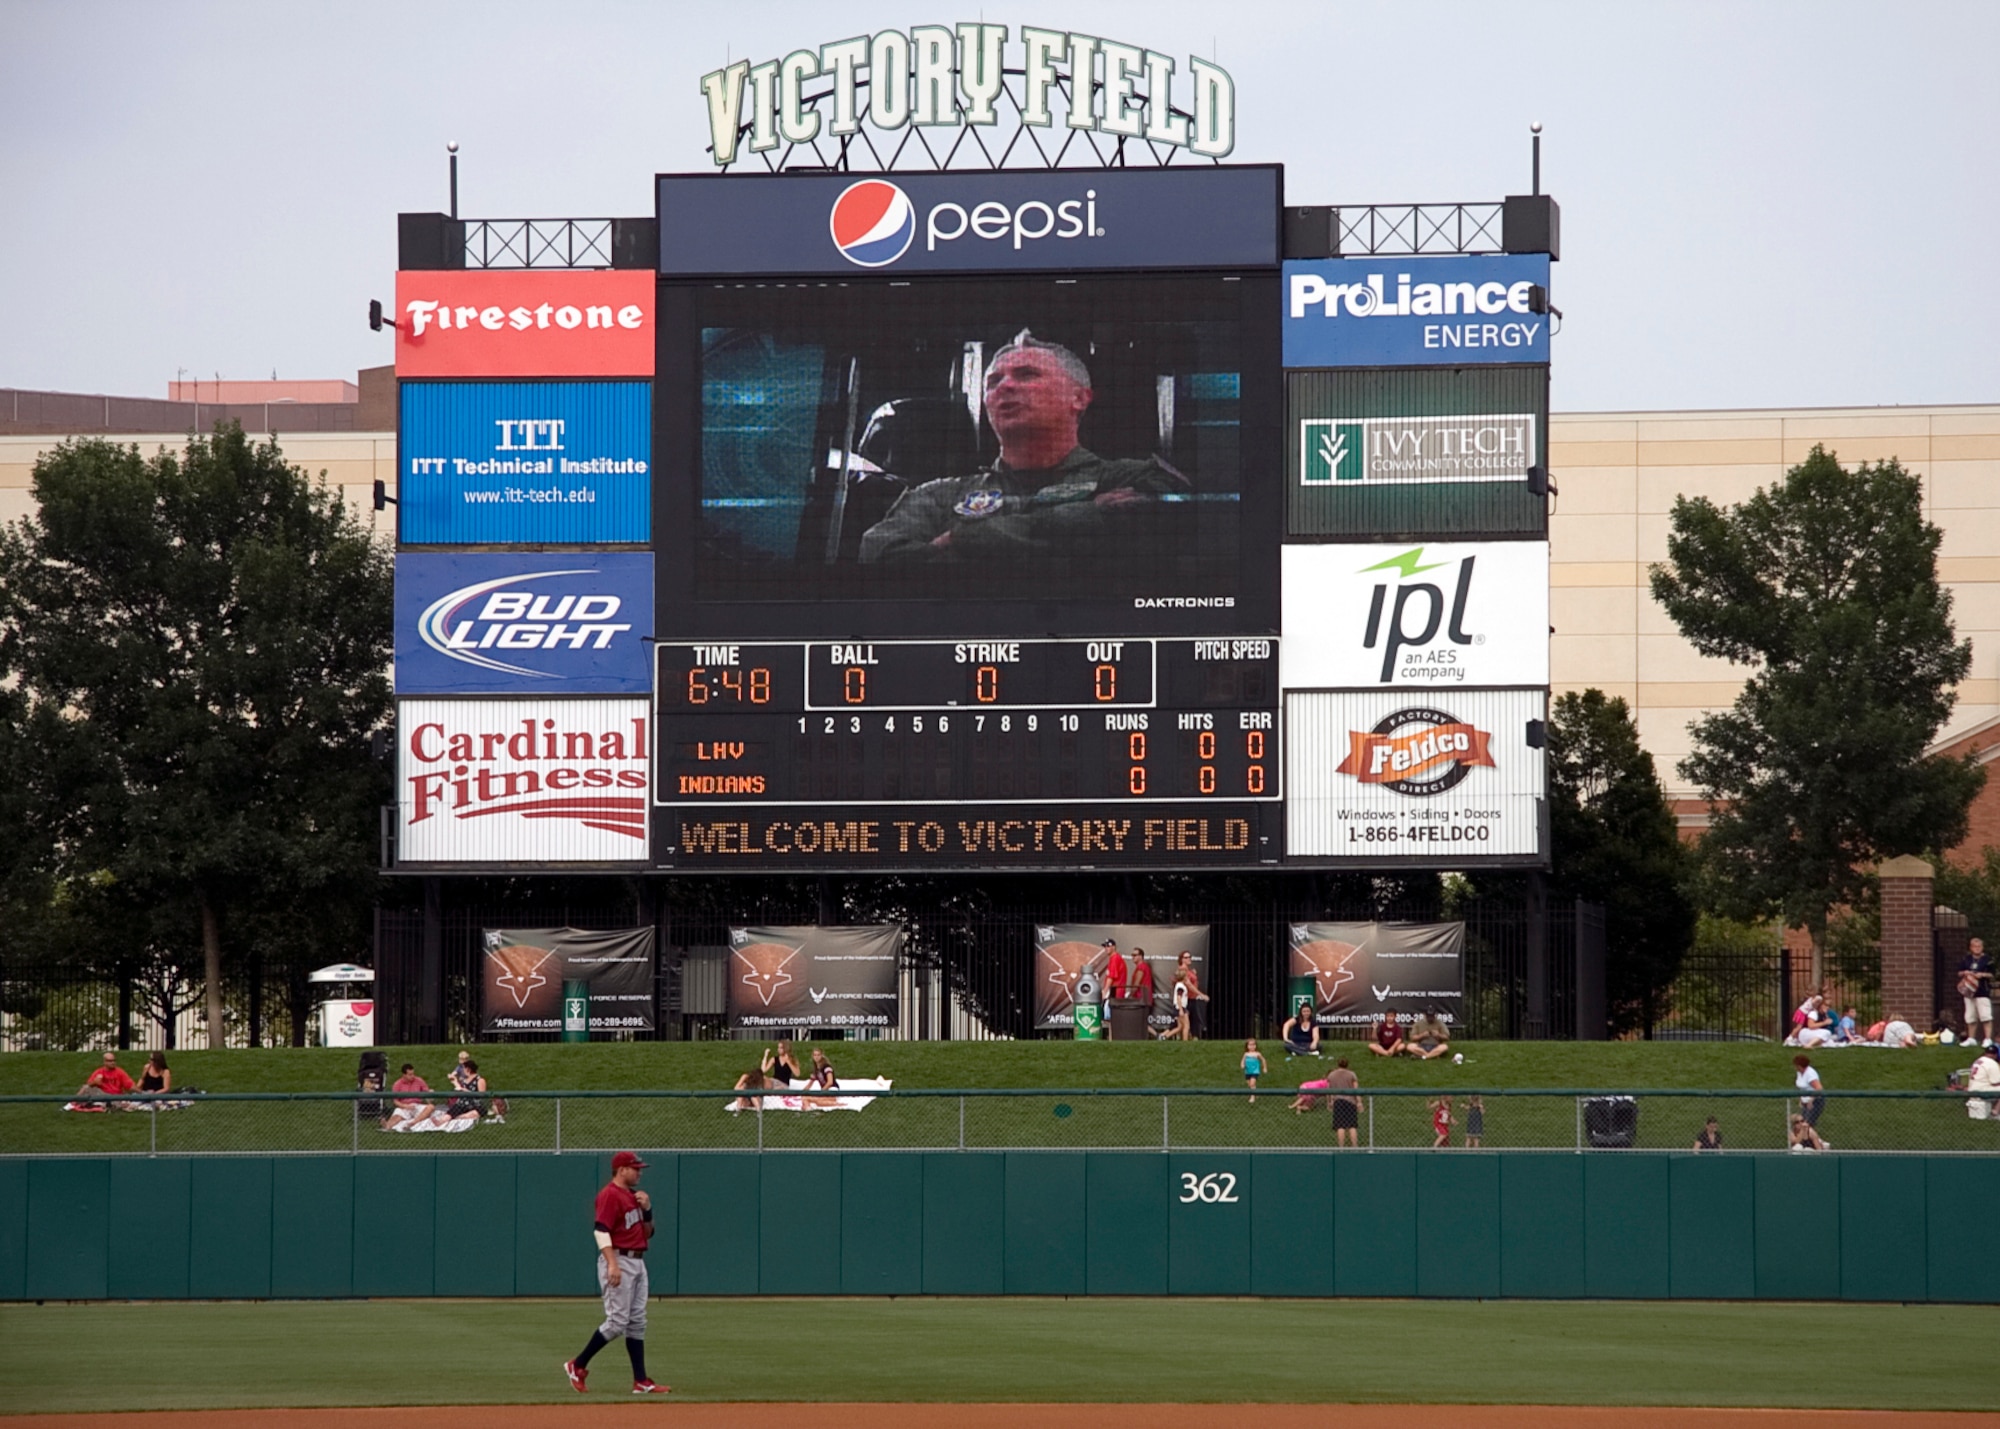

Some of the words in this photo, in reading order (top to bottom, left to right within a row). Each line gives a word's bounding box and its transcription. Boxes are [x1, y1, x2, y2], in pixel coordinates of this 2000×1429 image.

[701, 22, 1007, 165] VICTORY
[1020, 25, 1235, 159] FIELD
[927, 189, 1097, 251] pepsi
[1290, 273, 1535, 318] ProLiance
[406, 300, 643, 337] Firestone
[1424, 323, 1540, 349] ENERGY
[495, 419, 565, 450] ITT
[1372, 429, 1428, 457] IVY
[1436, 426, 1525, 454] TECH
[412, 458, 447, 474] ITT
[453, 457, 553, 475] Technical
[560, 457, 648, 474] Institute
[1372, 457, 1461, 472] COMMUNITY
[1463, 455, 1525, 469] COLLEGE
[464, 486, 596, 503] www.itt-tech.edu
[478, 592, 621, 620] BUD
[1134, 597, 1235, 608] DAKTRONICS
[1363, 555, 1476, 682] ipl
[446, 621, 631, 649] LIGHT
[693, 646, 740, 666] TIME
[831, 645, 879, 665] BALL
[954, 642, 1020, 663] STRIKE
[1086, 642, 1124, 662] OUT
[1194, 640, 1229, 661] PITCH
[1231, 640, 1270, 660] SPEED
[1405, 653, 1422, 664] an
[1426, 650, 1457, 663] AES
[688, 668, 770, 703] 6:48
[845, 667, 865, 703] 0
[977, 666, 997, 701] 0
[1095, 665, 1115, 700] 0
[1401, 666, 1465, 681] company
[797, 717, 806, 733] 1
[824, 717, 835, 733] 2
[850, 717, 861, 733] 3
[884, 716, 895, 732] 4
[913, 716, 923, 732] 5
[938, 716, 949, 732] 6
[975, 716, 985, 732] 7
[1000, 715, 1011, 732] 8
[1027, 715, 1037, 731] 9
[1059, 715, 1079, 731] 10
[1105, 714, 1149, 731] RUNS
[1178, 713, 1213, 730] HITS
[1239, 712, 1272, 729] ERR
[1389, 710, 1448, 727] FACTORY
[410, 718, 648, 763] Cardinal
[698, 742, 744, 760] LHV
[1130, 732, 1146, 760] 0
[1199, 731, 1215, 760] 0
[1247, 731, 1263, 760] 0
[1369, 731, 1469, 775] Feldco
[678, 776, 766, 794] INDIANS
[1130, 766, 1146, 795] 0
[1199, 765, 1215, 794] 0
[1247, 765, 1263, 793] 0
[1399, 781, 1446, 793] DIRECT
[408, 764, 647, 826] Fitness
[1337, 809, 1396, 821] Windows
[1410, 808, 1449, 822] Siding
[1464, 807, 1501, 820] Doors
[681, 822, 879, 854] WELCOME
[893, 821, 945, 853] TO
[957, 819, 1132, 852] VICTORY
[1144, 818, 1249, 851] FIELD
[1349, 825, 1489, 843] 1-866-4FELDCO
[1179, 1172, 1239, 1203] 362
